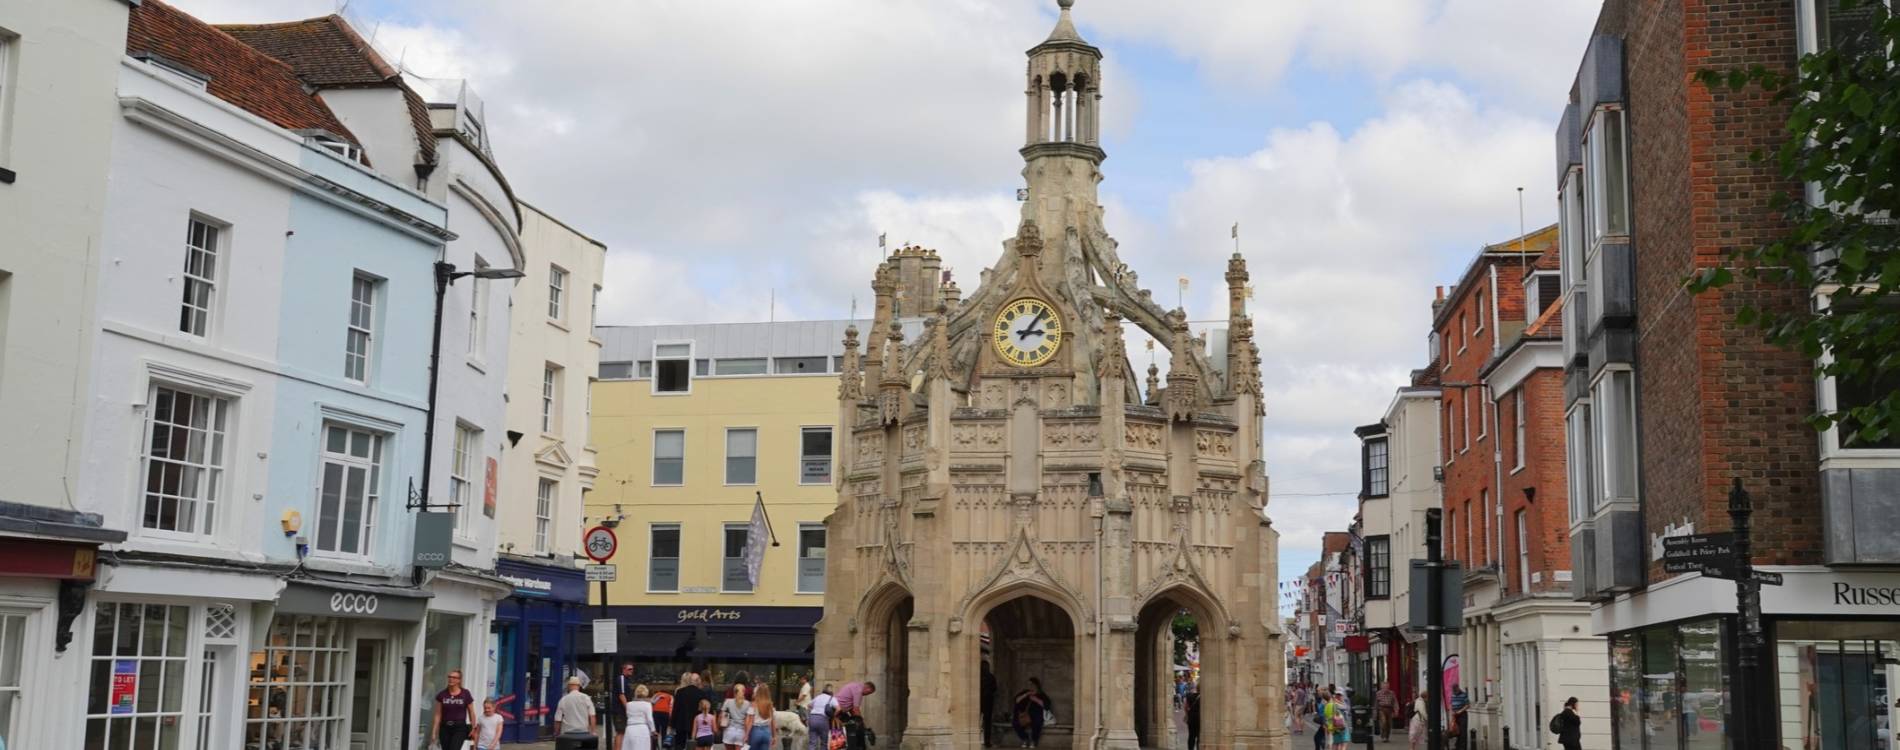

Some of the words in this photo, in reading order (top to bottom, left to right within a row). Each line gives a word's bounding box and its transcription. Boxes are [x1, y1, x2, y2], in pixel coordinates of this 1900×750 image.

[416, 552, 445, 561] ecco
[1718, 546, 1730, 554] Park
[1832, 581, 1900, 606] Russe
[330, 591, 378, 614] ecco
[677, 608, 708, 624] Gold
[709, 608, 741, 619] Arts
